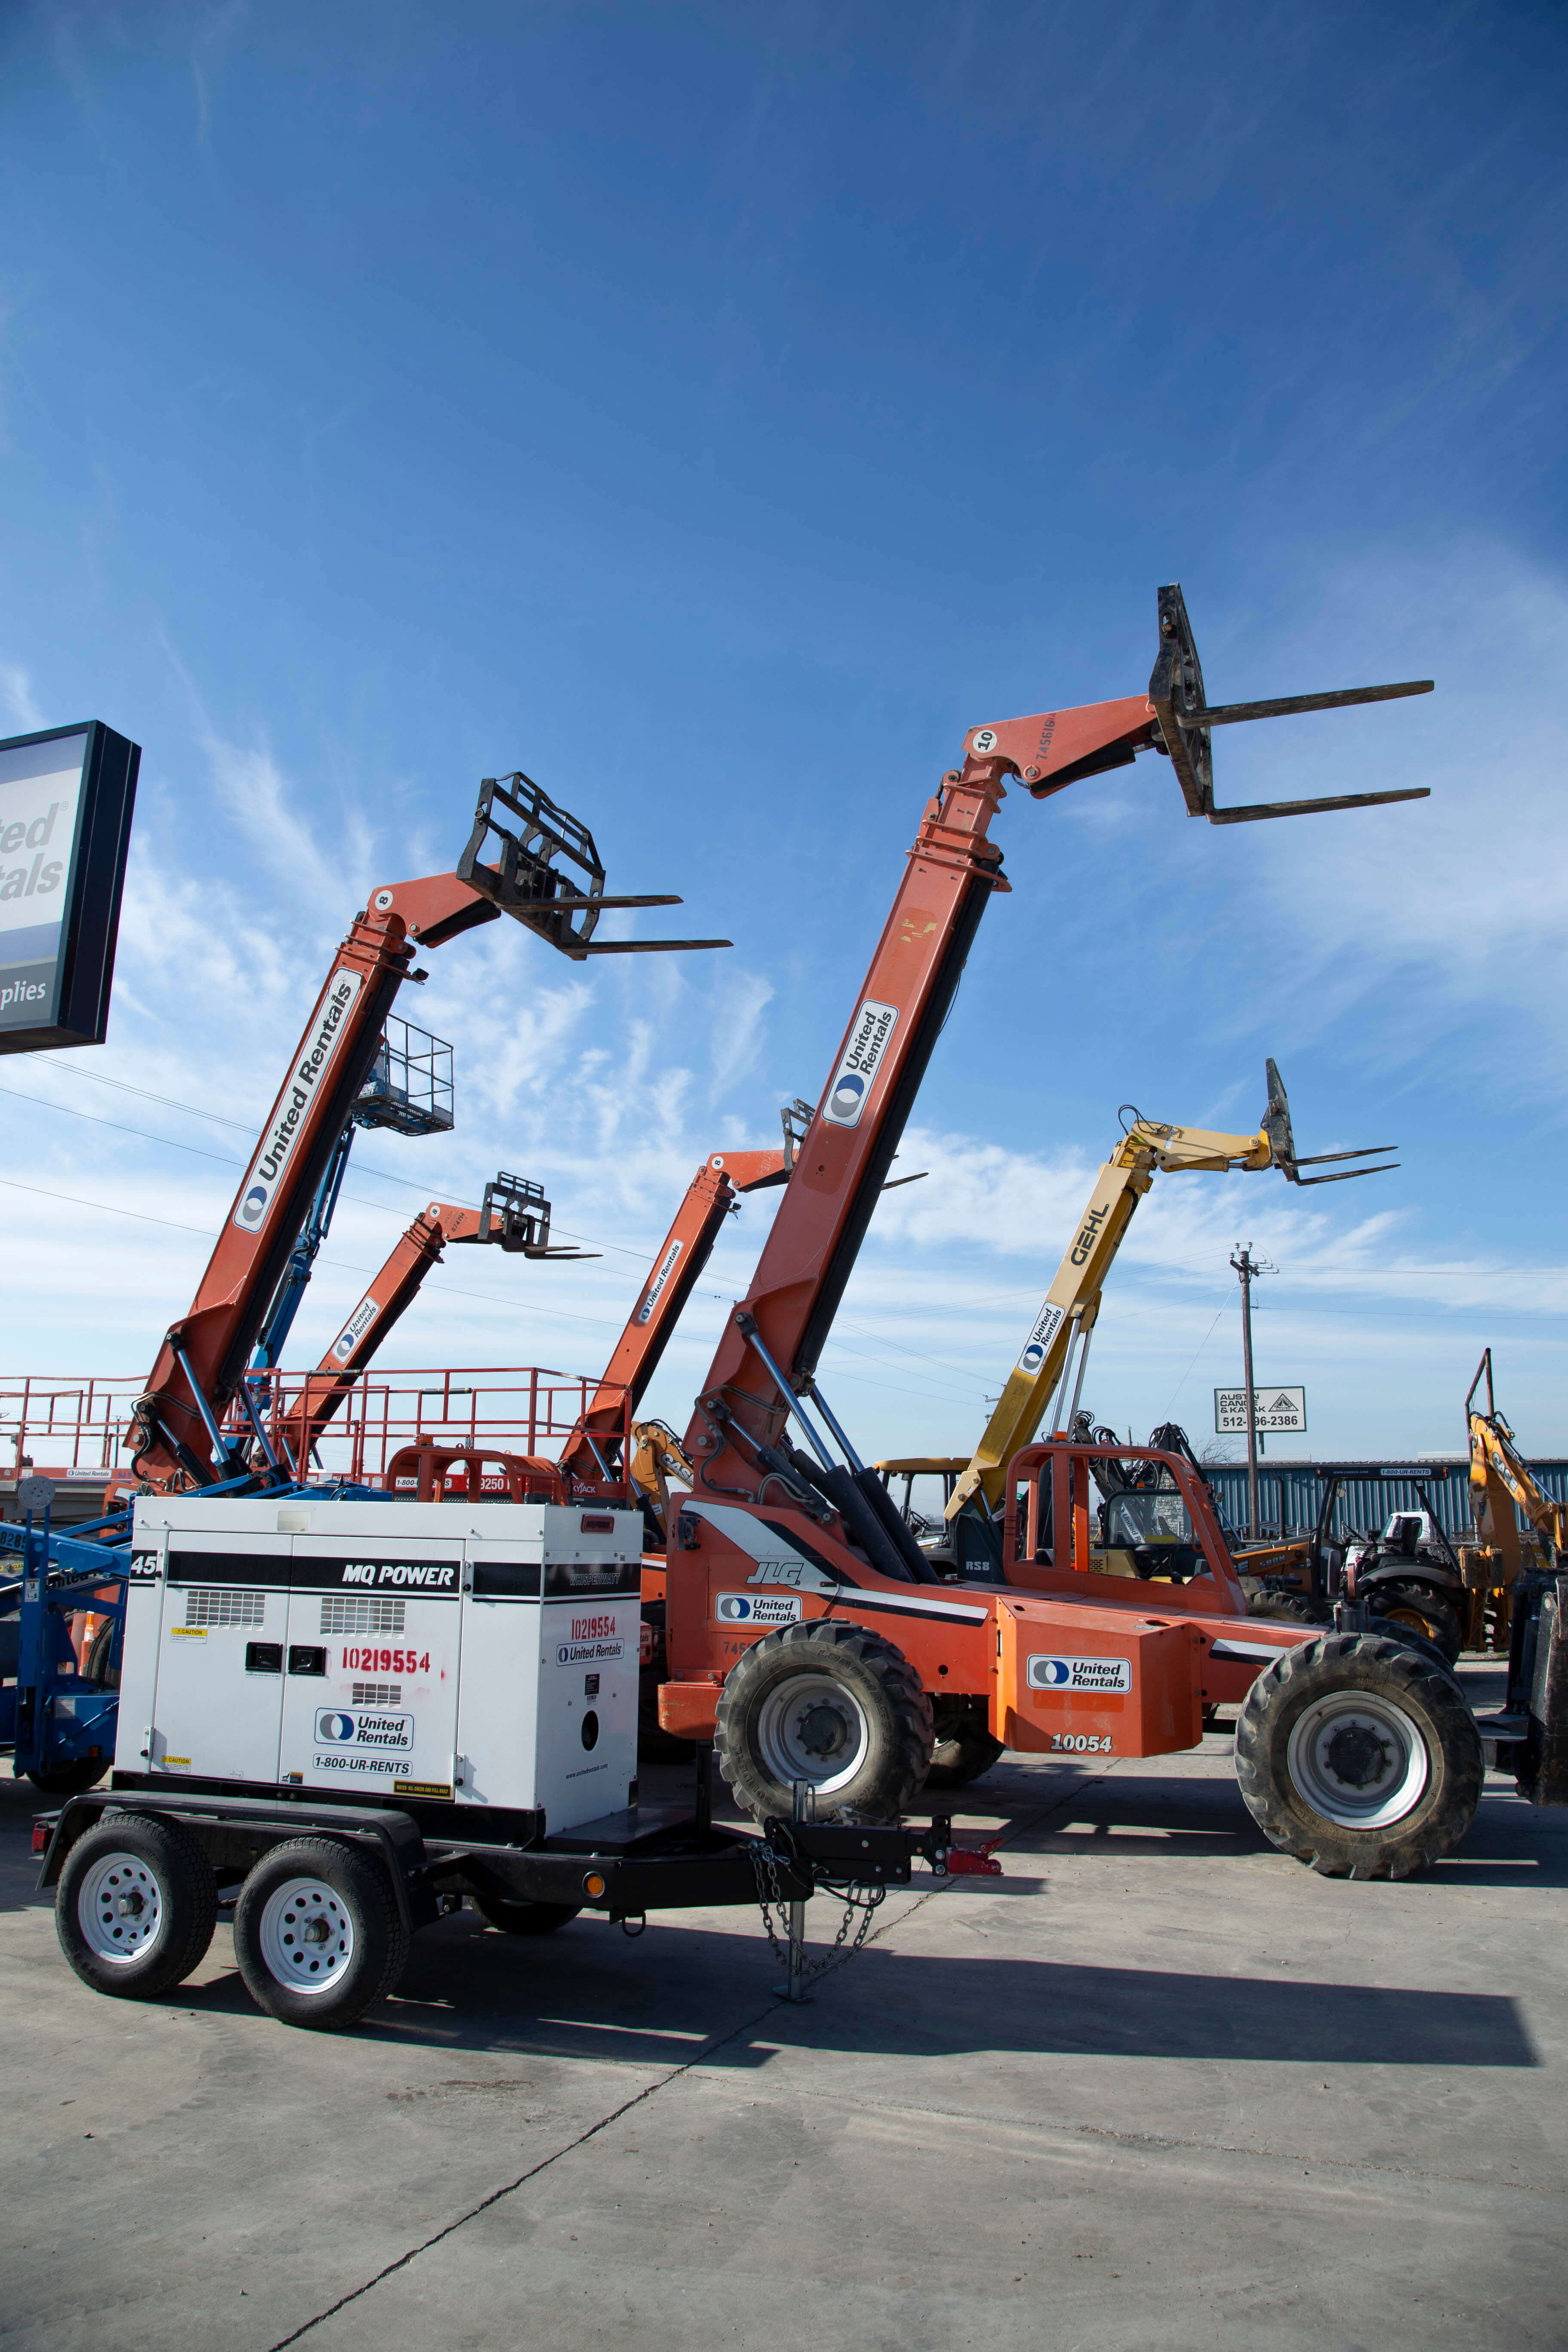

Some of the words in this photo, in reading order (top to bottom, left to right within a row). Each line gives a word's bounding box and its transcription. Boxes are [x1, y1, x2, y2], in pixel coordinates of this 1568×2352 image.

[978, 732, 993, 751] 10
[379, 896, 388, 905] 8
[846, 1011, 876, 1069] United
[859, 1012, 892, 1075] Rentals
[259, 1089, 308, 1182] United
[298, 983, 352, 1085] Rentals
[1071, 1204, 1109, 1266] GEHL
[647, 1277, 664, 1307] United
[661, 1245, 679, 1277] Rentals
[350, 1303, 370, 1332] United
[354, 1307, 376, 1338] Rentals
[1033, 1308, 1052, 1342] United
[1041, 1309, 1061, 1346] Rentals
[1223, 1416, 1298, 1427] 512-96-2386
[1492, 1452, 1518, 1493] CASE
[573, 1482, 596, 1494] KYJACK
[1123, 1513, 1138, 1535] United
[131, 1556, 157, 1574] 45
[745, 1562, 804, 1585] JLG
[966, 1561, 989, 1571] RS8
[342, 1565, 376, 1586] MQ
[378, 1565, 454, 1586] POWER
[570, 1573, 620, 1585] WHISPERWATT
[753, 1599, 793, 1610] United
[753, 1610, 796, 1621] Rentals
[572, 1616, 616, 1640] 10219554
[570, 1646, 594, 1660] United
[596, 1642, 621, 1658] Rentals
[724, 1641, 752, 1655] 745
[342, 1647, 430, 1673] 10219554
[1072, 1662, 1121, 1675] United
[1072, 1674, 1124, 1687] Rentals
[817, 1649, 893, 1757] LOADMASTER
[358, 1716, 405, 1732] United
[357, 1730, 408, 1746] Rentals
[1050, 1733, 1112, 1753] 10054
[315, 1756, 410, 1774] 1-800-UR-RENTS
[566, 1764, 608, 1779] www.unitedrentals.com
